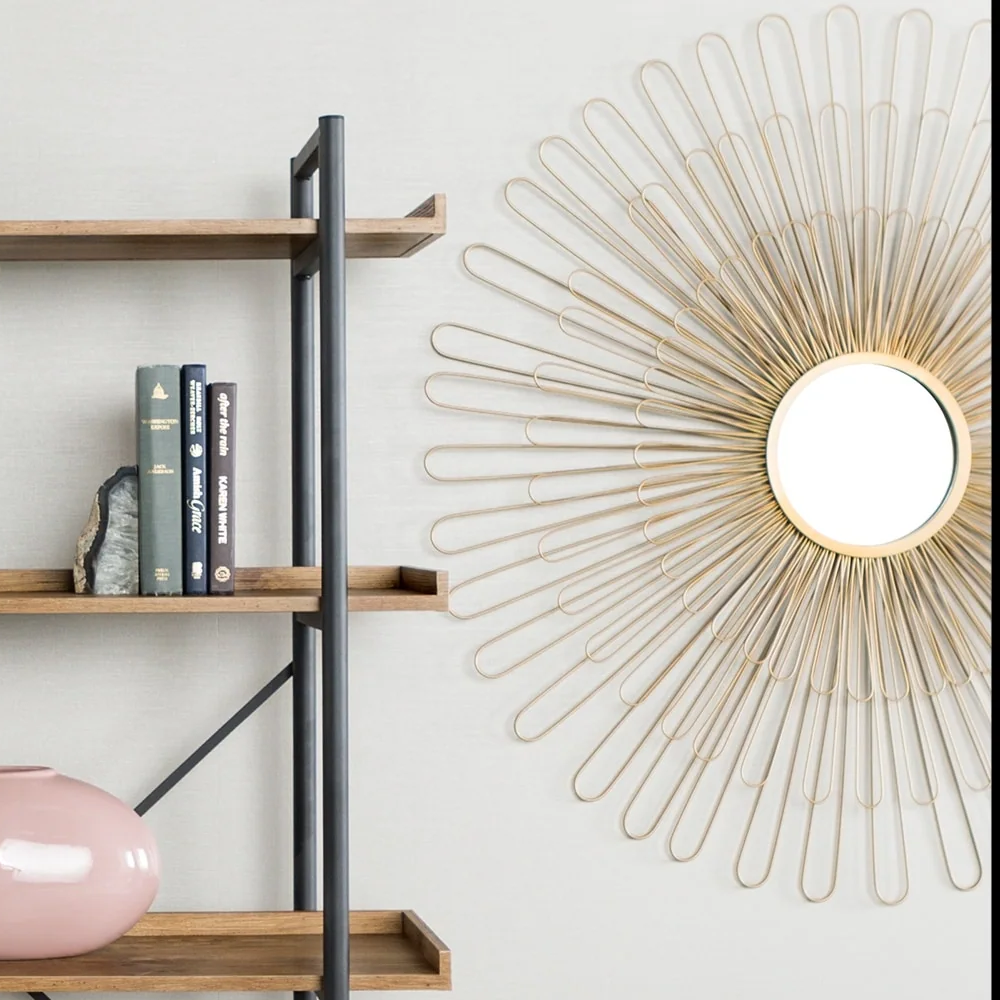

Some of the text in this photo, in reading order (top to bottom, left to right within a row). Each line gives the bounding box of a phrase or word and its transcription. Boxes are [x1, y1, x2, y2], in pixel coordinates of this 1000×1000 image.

[217, 392, 230, 456] after the rain
[186, 467, 206, 534] Amish Grace
[218, 476, 228, 544] KAREN WHITE
